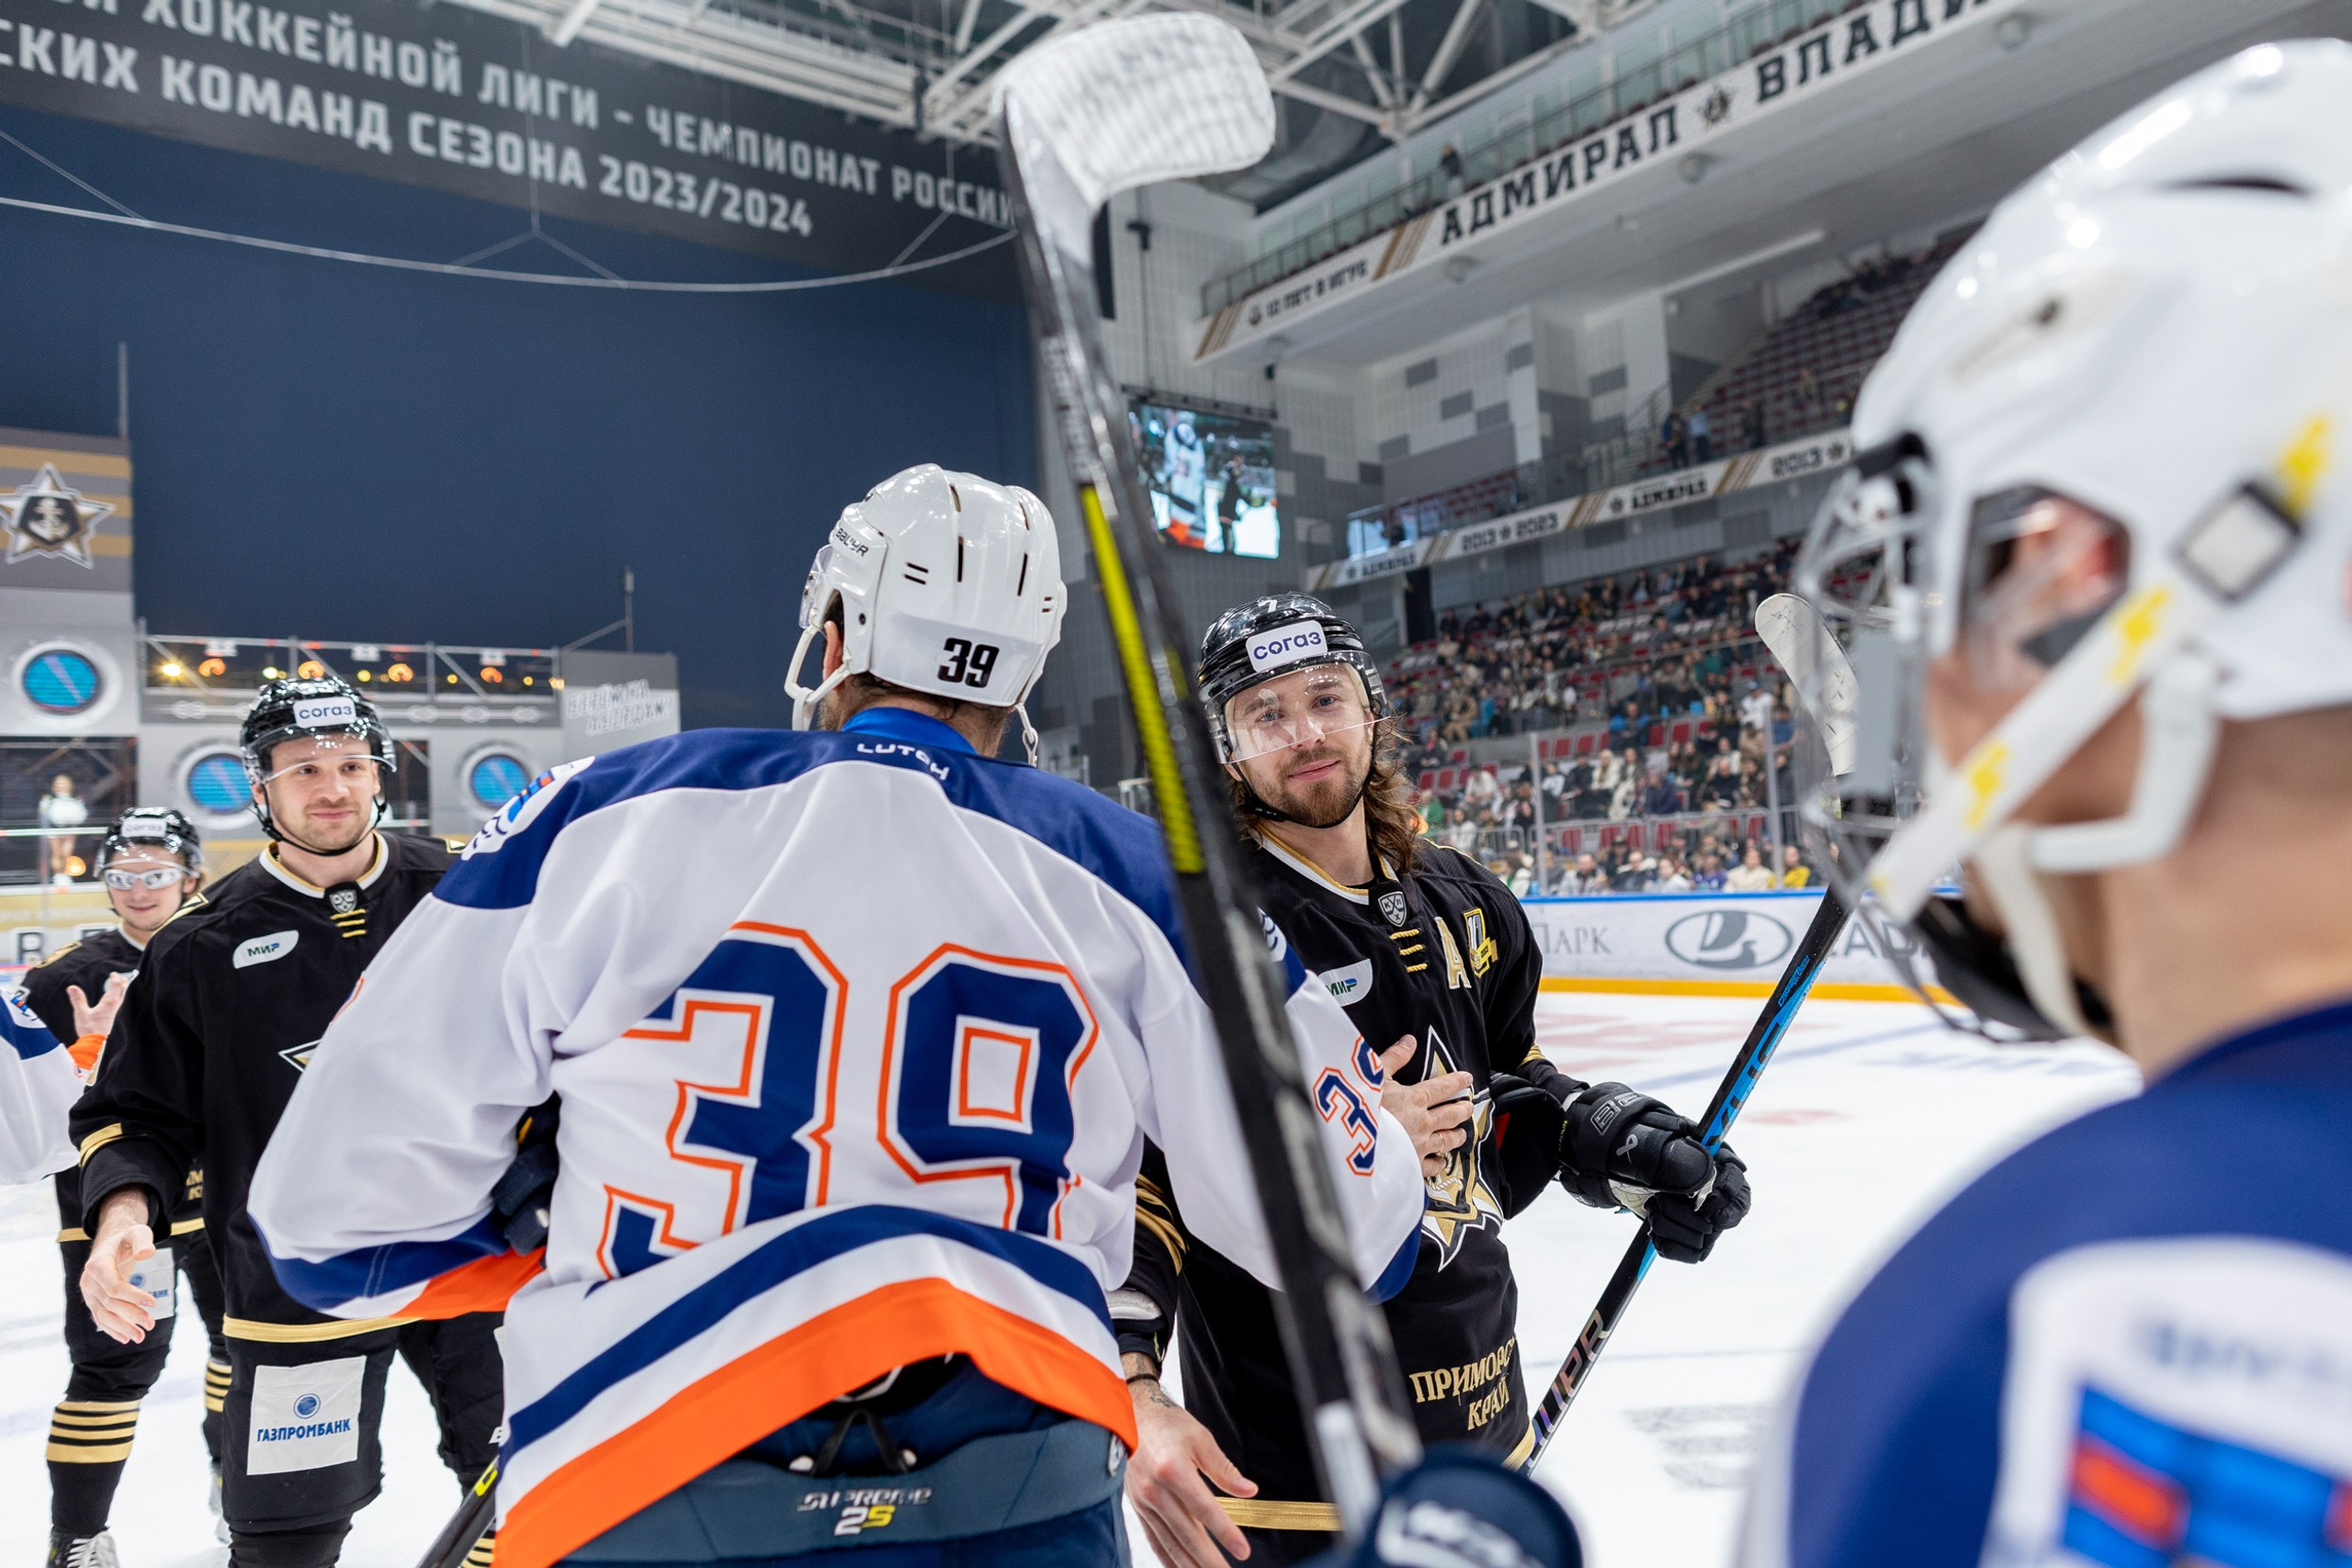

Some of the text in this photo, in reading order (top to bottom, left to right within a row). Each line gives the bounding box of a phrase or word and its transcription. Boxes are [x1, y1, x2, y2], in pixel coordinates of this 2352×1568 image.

[160, 53, 392, 154] КОМАНД
[408, 111, 586, 190] СЕЗОНА
[597, 154, 813, 238] 2023/2024
[478, 62, 598, 130] ЛИГИ
[646, 103, 881, 196] ЧЕМПИОНАТ
[891, 164, 1017, 227] РОССИИ
[1441, 105, 1680, 246] АДМИРАЛ
[937, 637, 1000, 689] 39
[857, 742, 950, 781] LUTCH
[247, 942, 280, 957] МИР
[597, 919, 1099, 1280] 39
[1409, 1336, 1516, 1403] ПРИМОРС
[1467, 1371, 1510, 1430] КРАЙ
[256, 1417, 351, 1443] ГАЗПРОМБАНК
